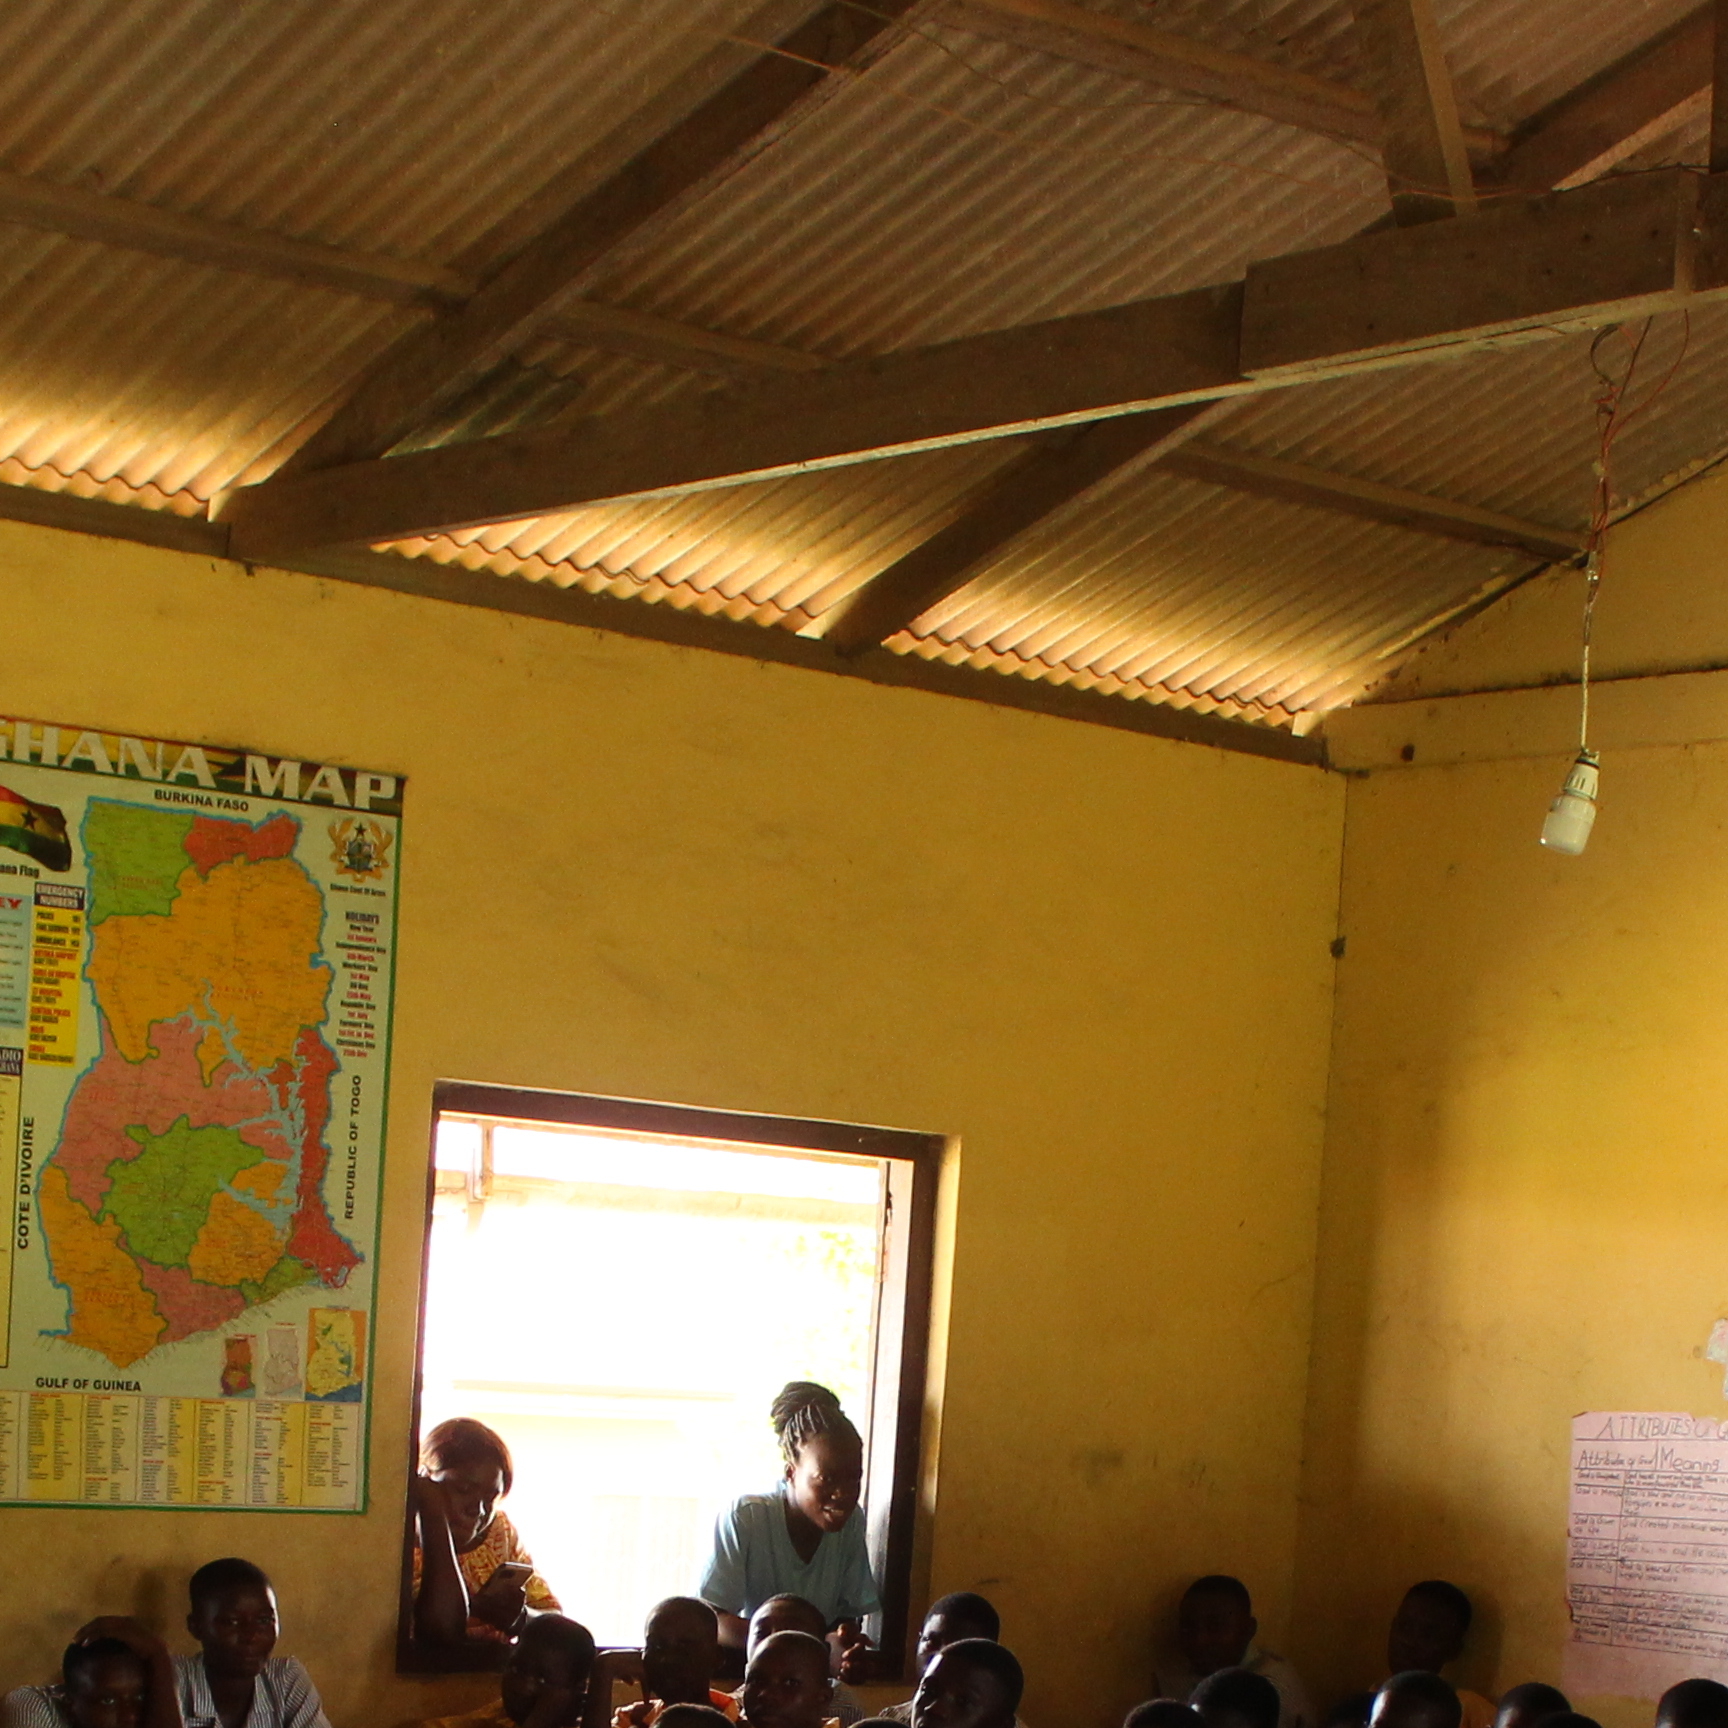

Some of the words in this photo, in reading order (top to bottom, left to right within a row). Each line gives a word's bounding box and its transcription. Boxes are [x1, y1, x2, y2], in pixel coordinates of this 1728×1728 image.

[243, 754, 397, 809] MAP
[154, 790, 213, 807] BURKINA
[217, 798, 249, 812] FASO
[20, 865, 39, 879] Flag
[351, 1075, 362, 1117] TOGO
[349, 1121, 359, 1140] OF
[20, 1117, 35, 1195] D'IVOIRE
[345, 1146, 357, 1220] REPUBLIC
[17, 1202, 30, 1249] COTE
[35, 1377, 69, 1388] GULF
[73, 1378, 89, 1389] OF
[93, 1379, 141, 1391] GUINEA
[1596, 1416, 1691, 1439] ATTRIBUTES
[1661, 1447, 1720, 1472] Meaning
